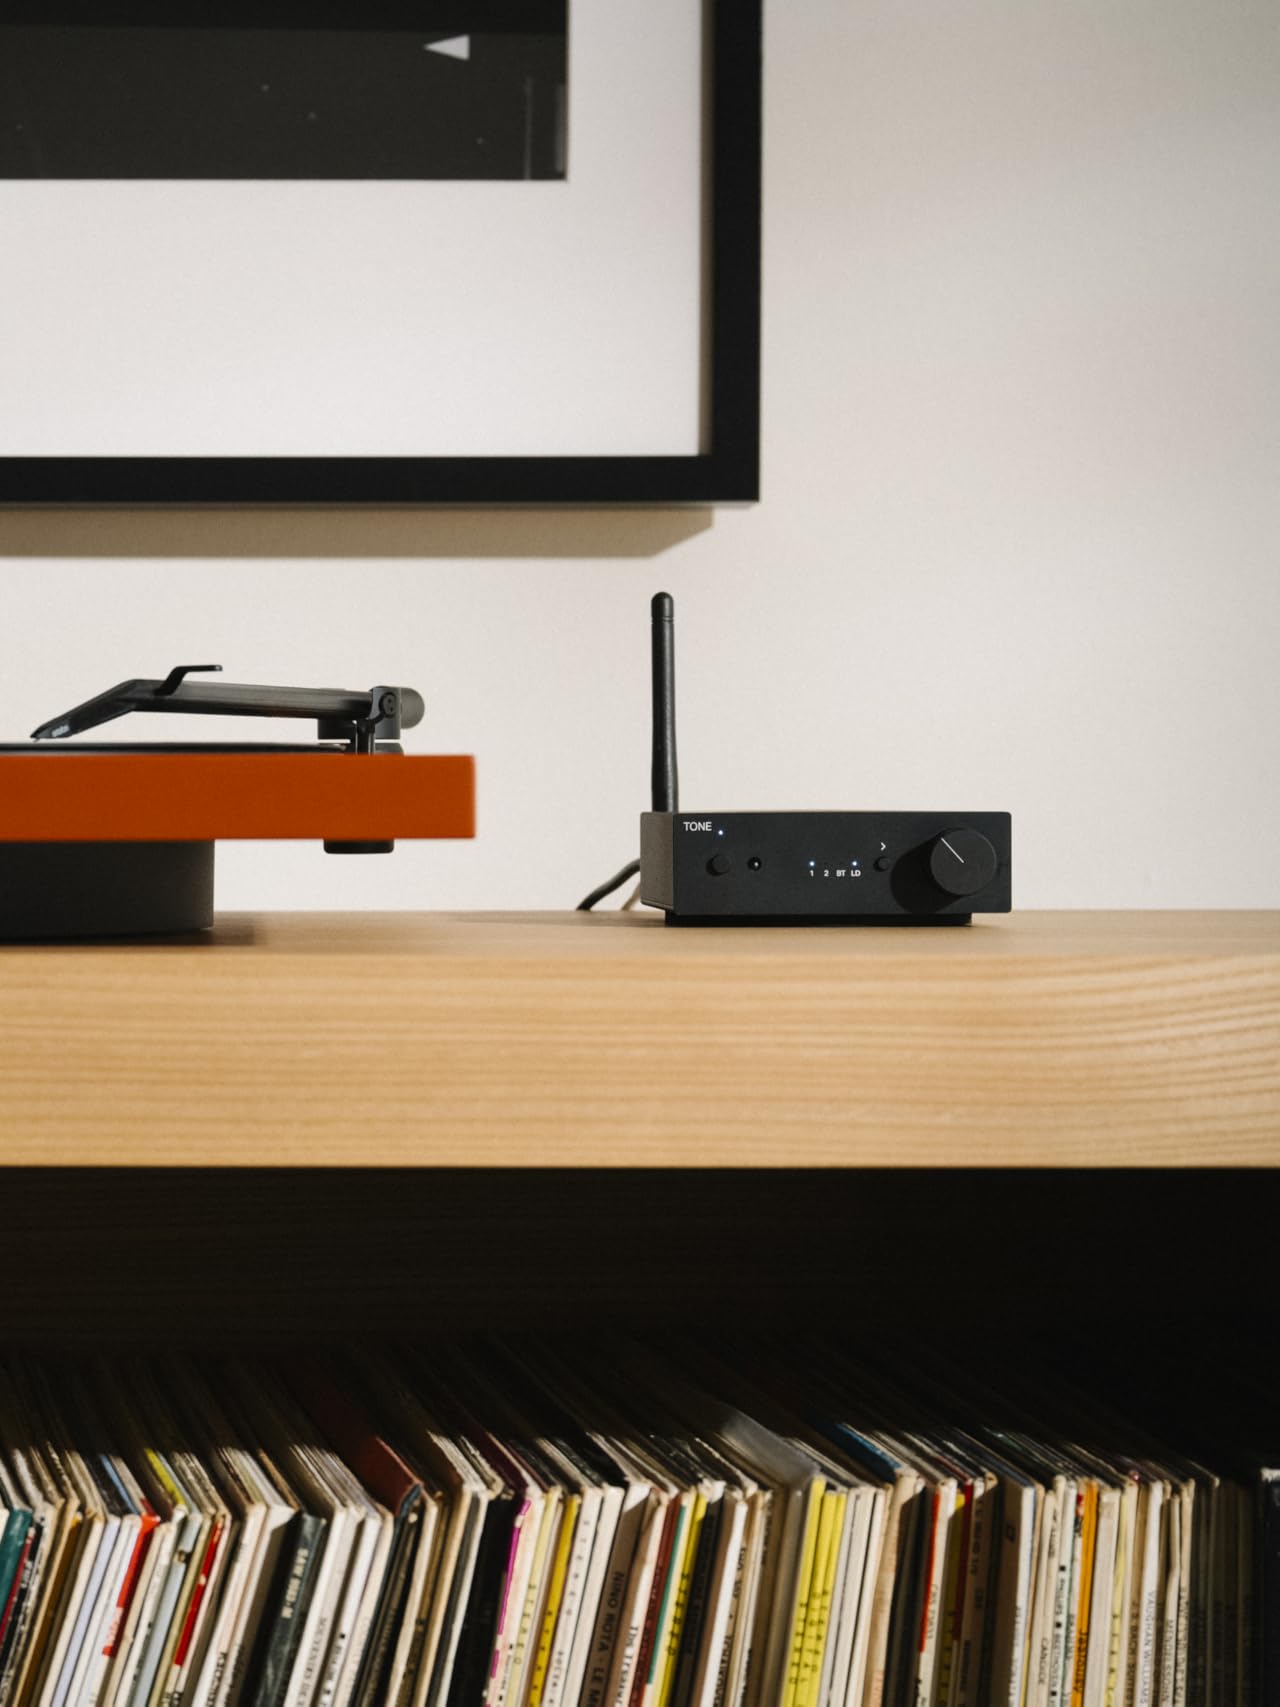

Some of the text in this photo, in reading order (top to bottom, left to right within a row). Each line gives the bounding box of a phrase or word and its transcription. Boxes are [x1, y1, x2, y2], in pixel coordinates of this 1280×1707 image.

[682, 820, 713, 832] TONE
[809, 869, 862, 878] 1 2 BT LD
[606, 1571, 624, 1609] NINO
